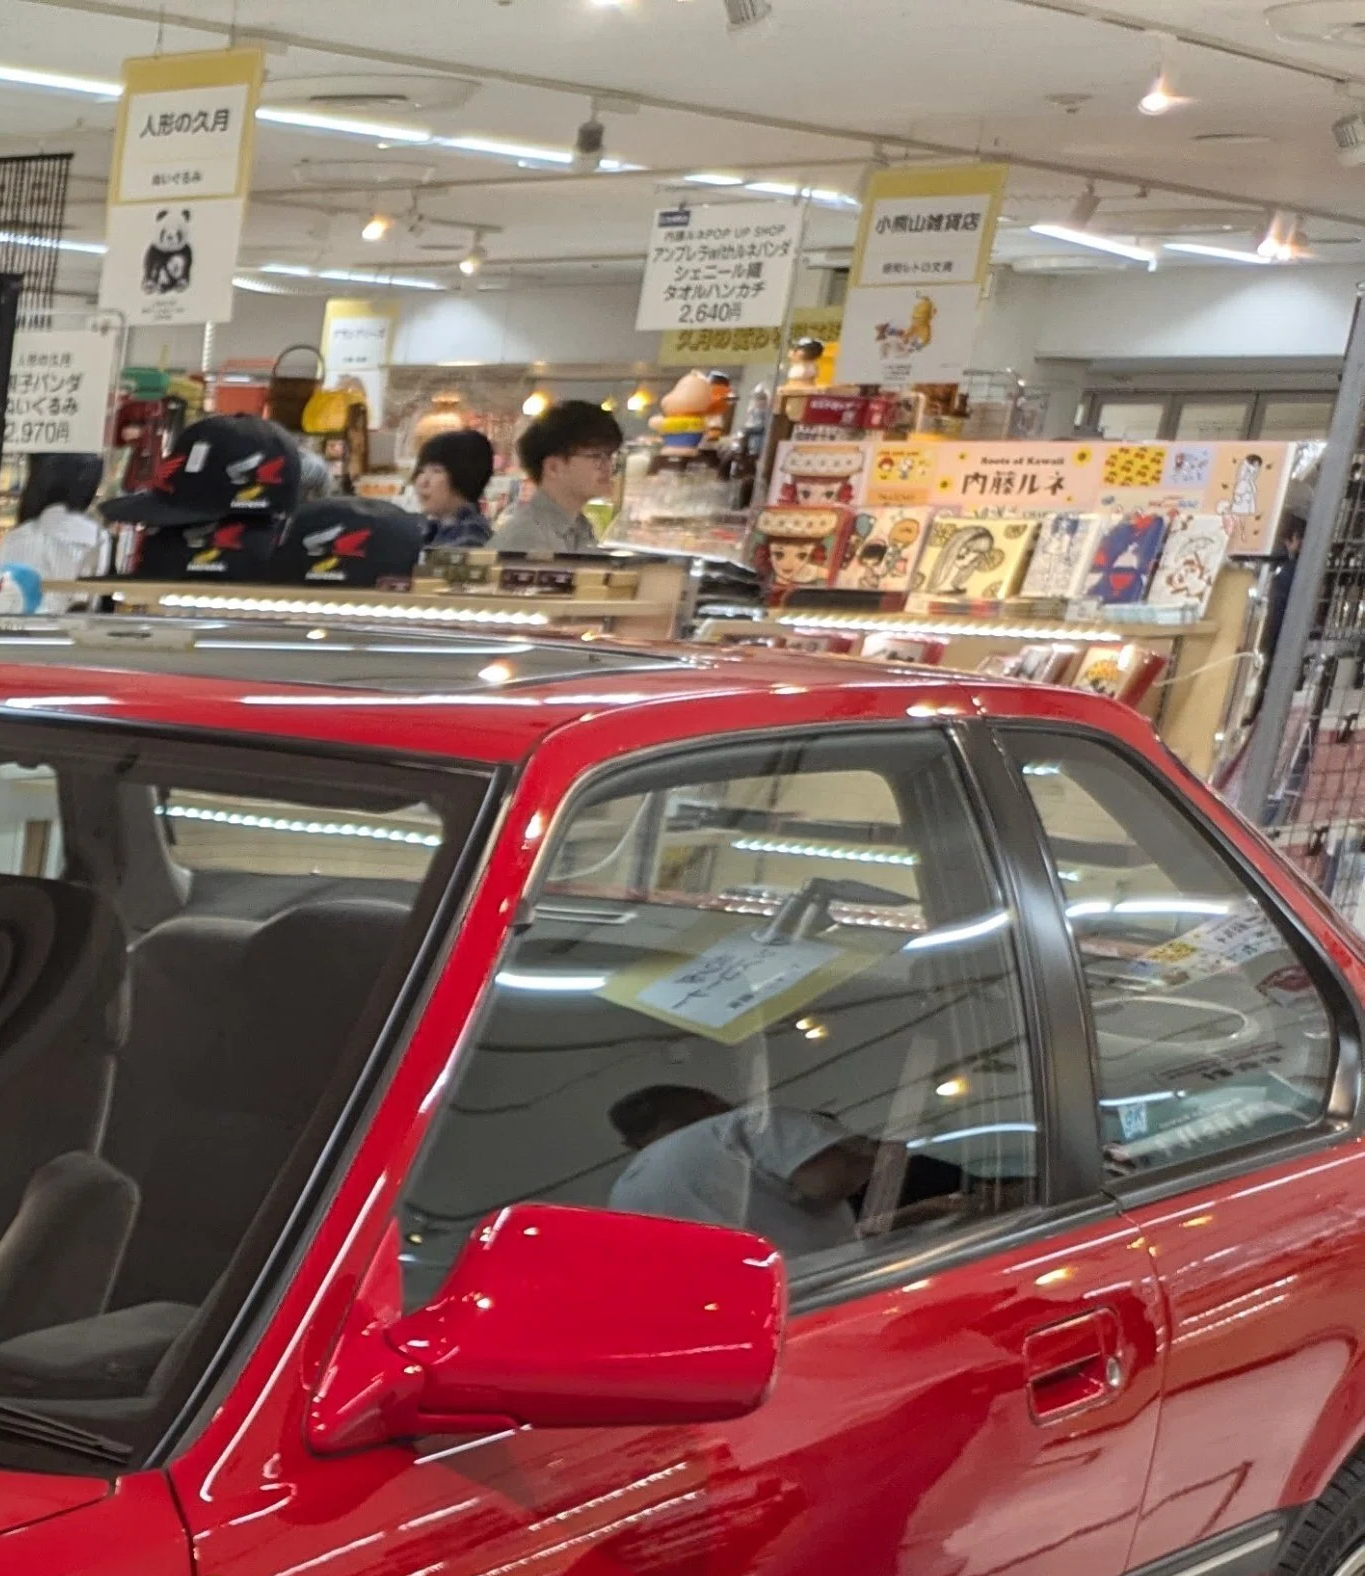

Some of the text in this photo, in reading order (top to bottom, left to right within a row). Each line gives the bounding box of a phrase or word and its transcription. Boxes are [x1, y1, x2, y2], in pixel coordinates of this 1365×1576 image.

[140, 108, 230, 139] 人形の久月
[152, 170, 202, 186] ぬいぐるみ
[753, 224, 785, 236] SHOP
[875, 212, 980, 235] 小熊山雑貨店
[663, 281, 766, 302] タオルハンカチ
[678, 302, 742, 325] 2,640円
[961, 471, 1066, 496] 内藤ルネ
